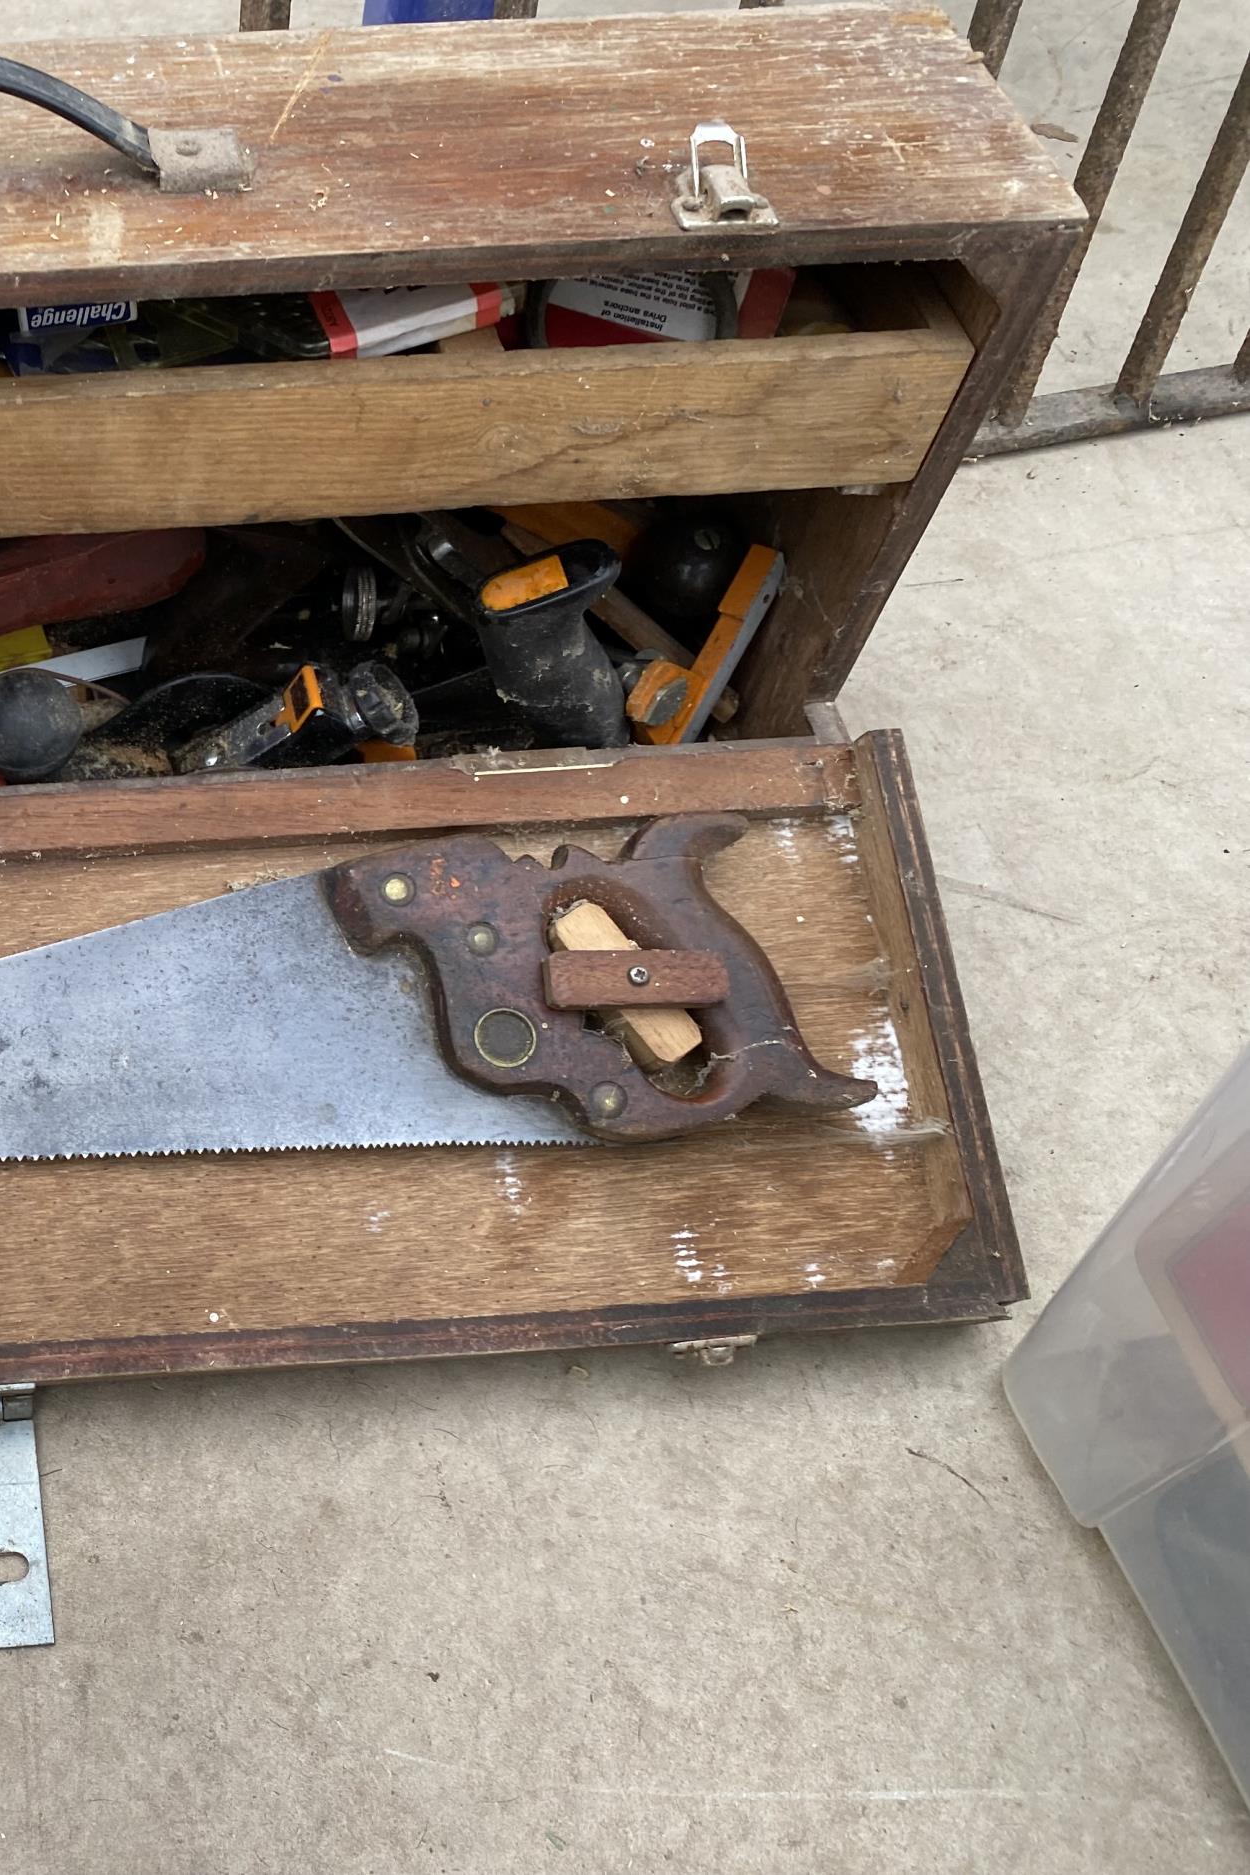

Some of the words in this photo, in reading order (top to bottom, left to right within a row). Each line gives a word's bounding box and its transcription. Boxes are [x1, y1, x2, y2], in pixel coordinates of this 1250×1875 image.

[31, 302, 127, 328] Challenge
[600, 309, 611, 317] of
[603, 299, 641, 315] anchors
[613, 312, 664, 332] Installation
